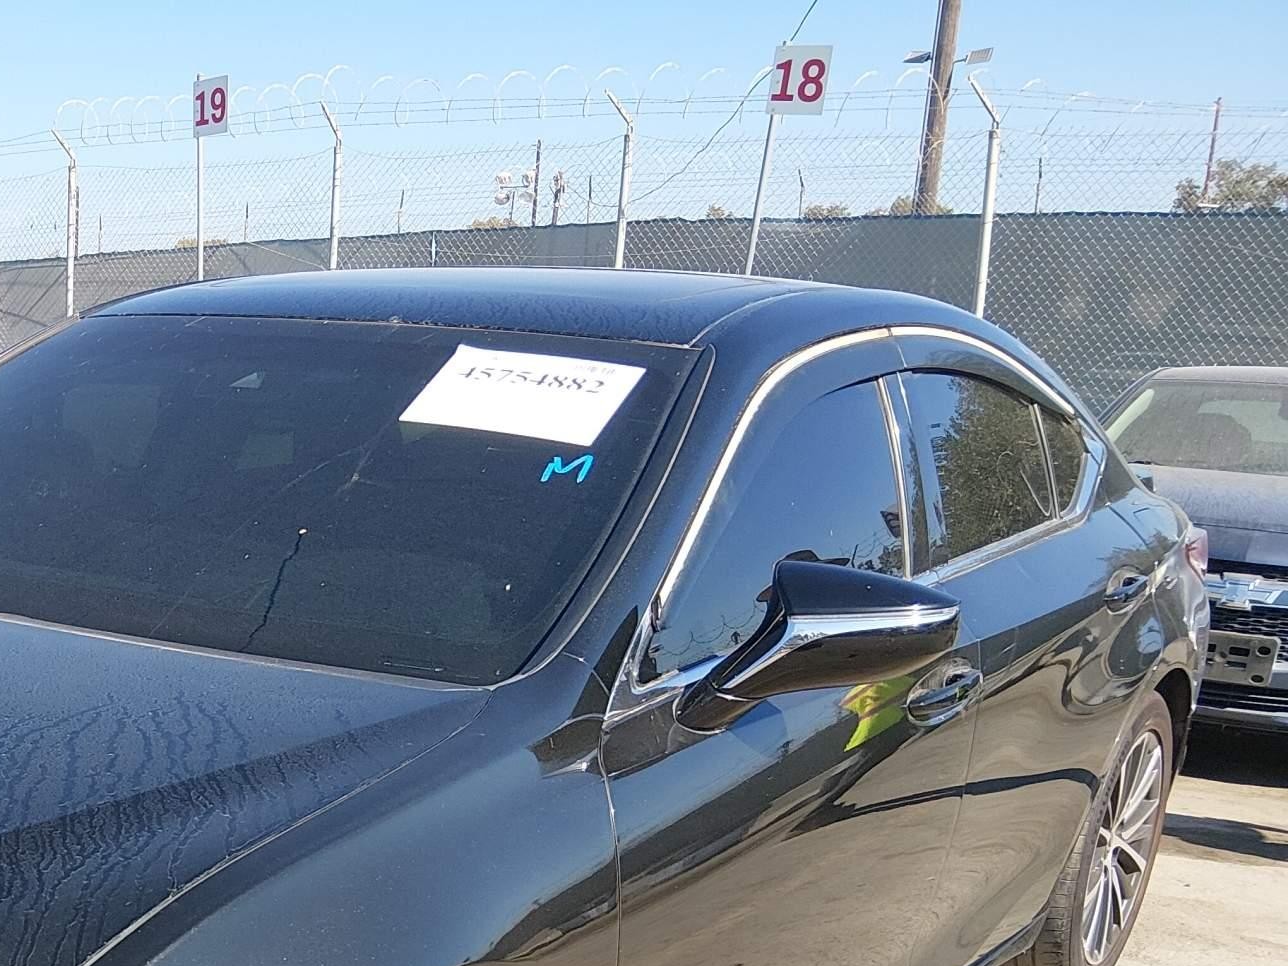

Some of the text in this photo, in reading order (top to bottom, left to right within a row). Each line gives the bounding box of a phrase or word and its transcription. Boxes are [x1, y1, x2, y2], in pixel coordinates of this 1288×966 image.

[770, 58, 826, 103] 18
[194, 87, 228, 127] 19
[459, 366, 605, 394] 45754882
[539, 453, 594, 484] M
